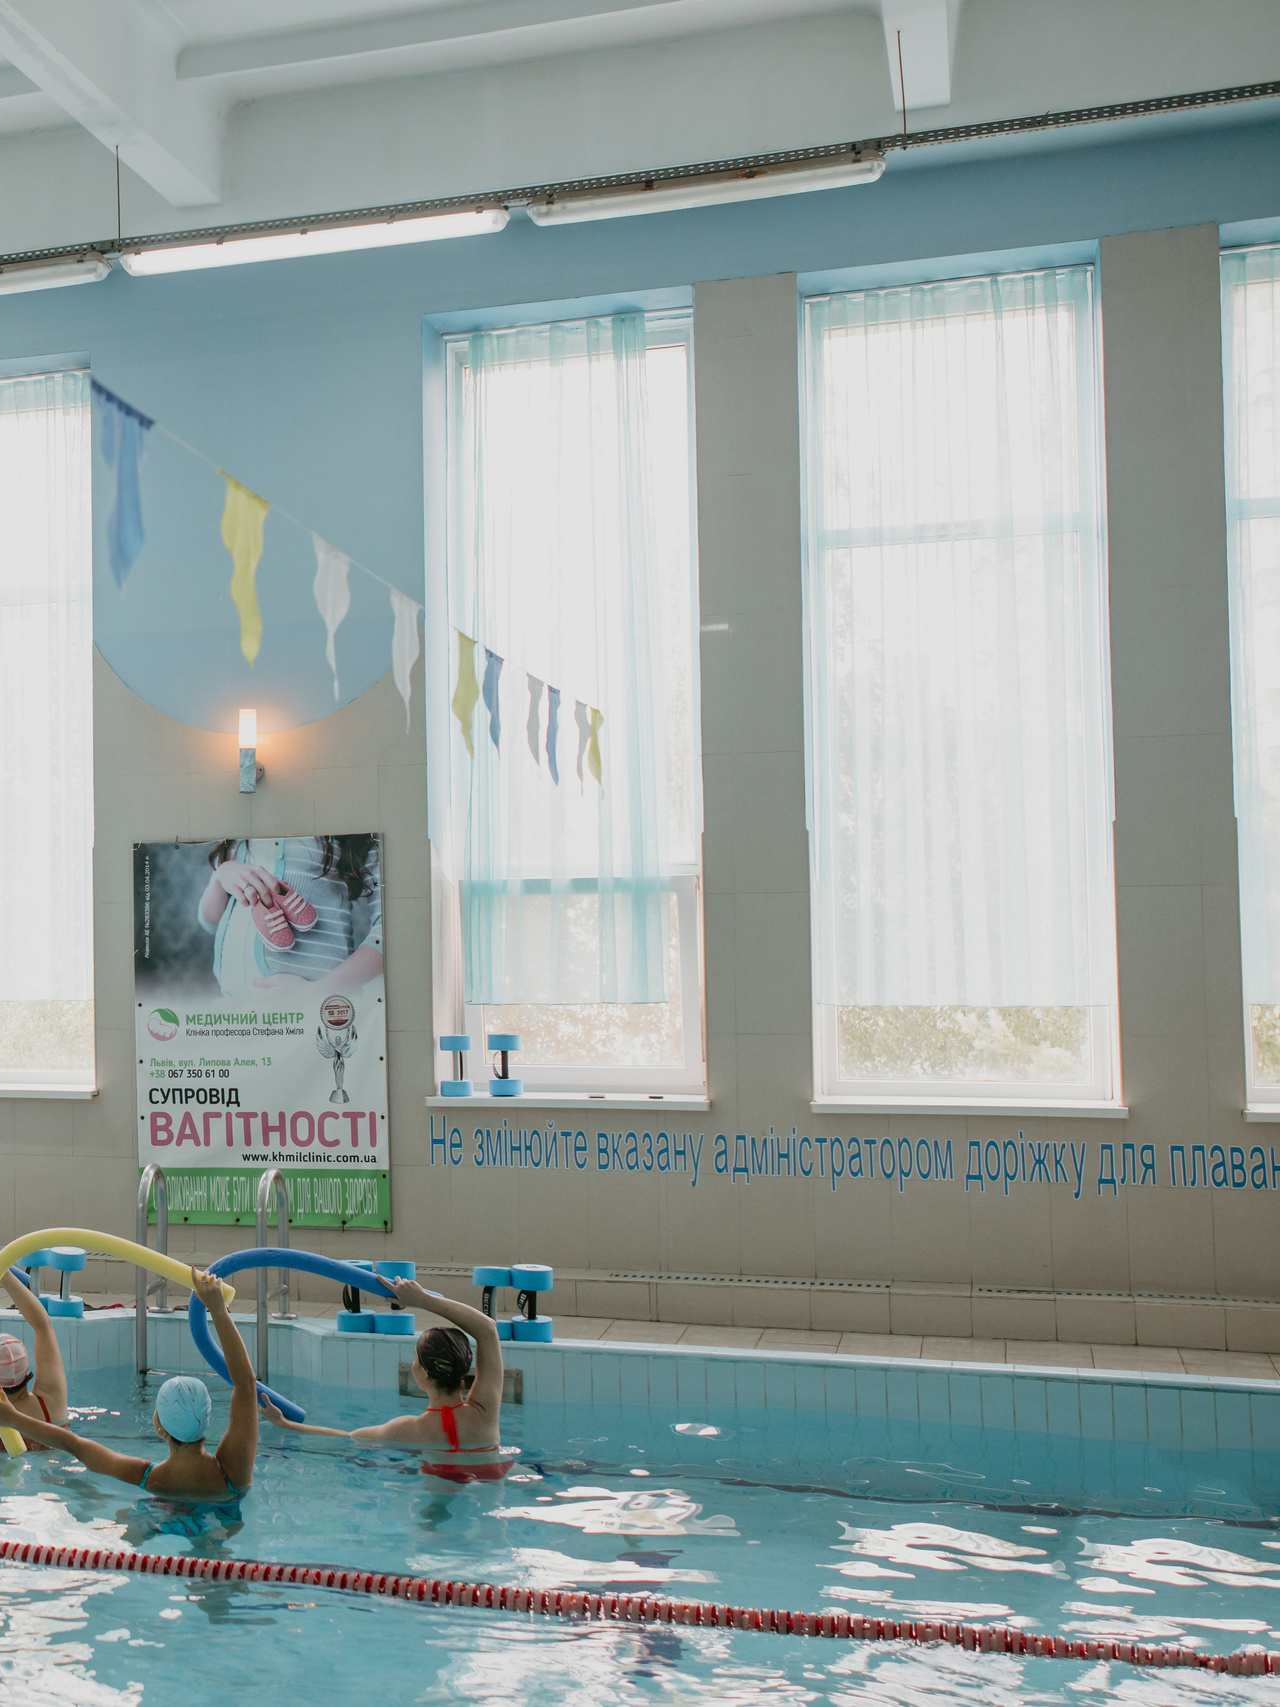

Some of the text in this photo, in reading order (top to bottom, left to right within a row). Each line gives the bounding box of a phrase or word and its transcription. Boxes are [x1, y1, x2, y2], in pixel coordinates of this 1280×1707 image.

[186, 1011, 304, 1026] МЕДИЧНИЙ ЦЕНТР
[186, 1027, 304, 1037] Клініка професора Стефана Хміля
[150, 1057, 272, 1069] Львів, вул. Липова Алея, 13
[150, 1069, 230, 1078] +38 067 350 61 00
[149, 1088, 241, 1107] СУПРОВІД
[150, 1111, 377, 1148] ВАГІТНОСТІ
[242, 1152, 377, 1163] www.khmilclinic.com.ua
[430, 1114, 463, 1166] Не
[473, 1119, 588, 1169] змінюйте
[597, 1131, 704, 1187] вказану
[714, 1127, 954, 1193] адміністратором
[965, 1131, 1086, 1199] доріжку
[1098, 1143, 1157, 1197] для
[210, 1176, 230, 1211] МОЖЕ
[233, 1176, 250, 1212] БУТИ
[297, 1178, 311, 1219] ДЛЯ
[314, 1178, 342, 1214] ВАШОГО
